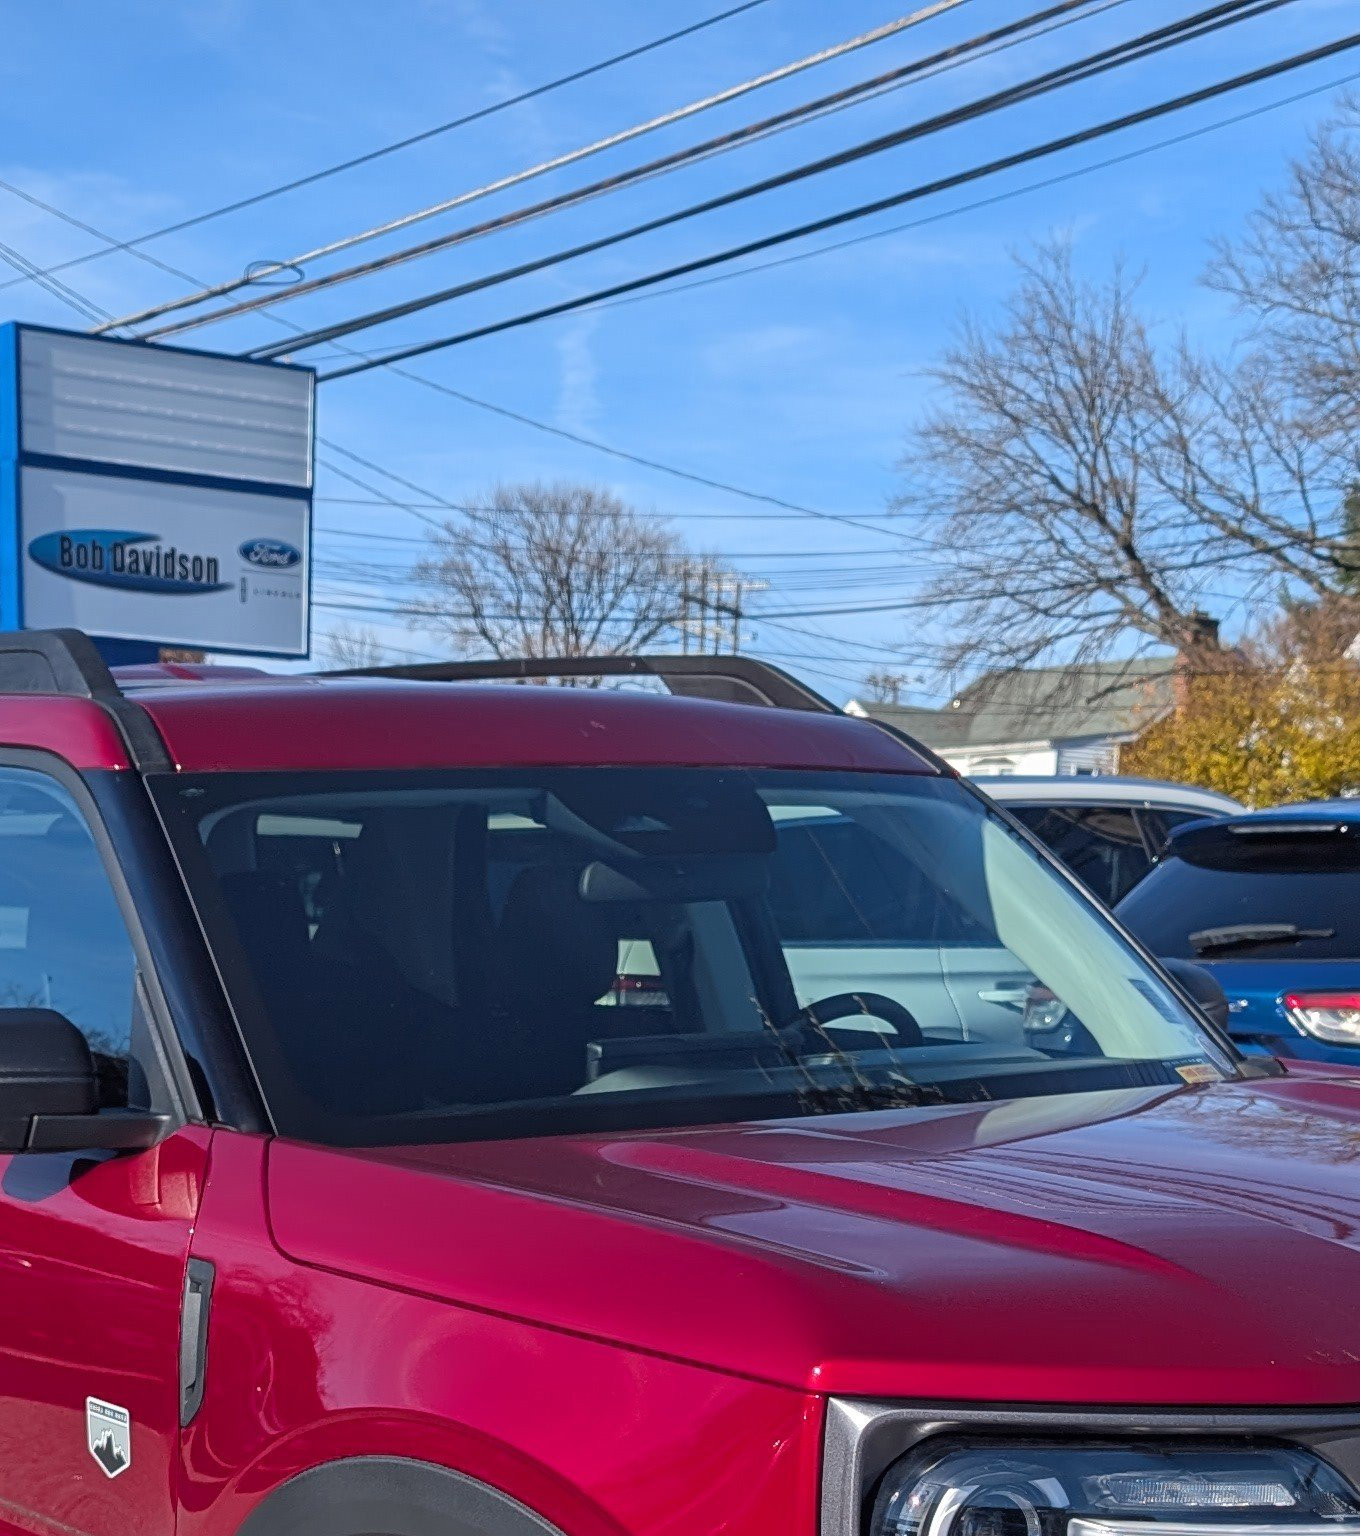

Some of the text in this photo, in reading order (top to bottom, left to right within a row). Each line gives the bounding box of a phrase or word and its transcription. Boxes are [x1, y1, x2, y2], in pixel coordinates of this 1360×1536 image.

[59, 536, 220, 585] Bob Davidson
[246, 541, 295, 566] Ford
